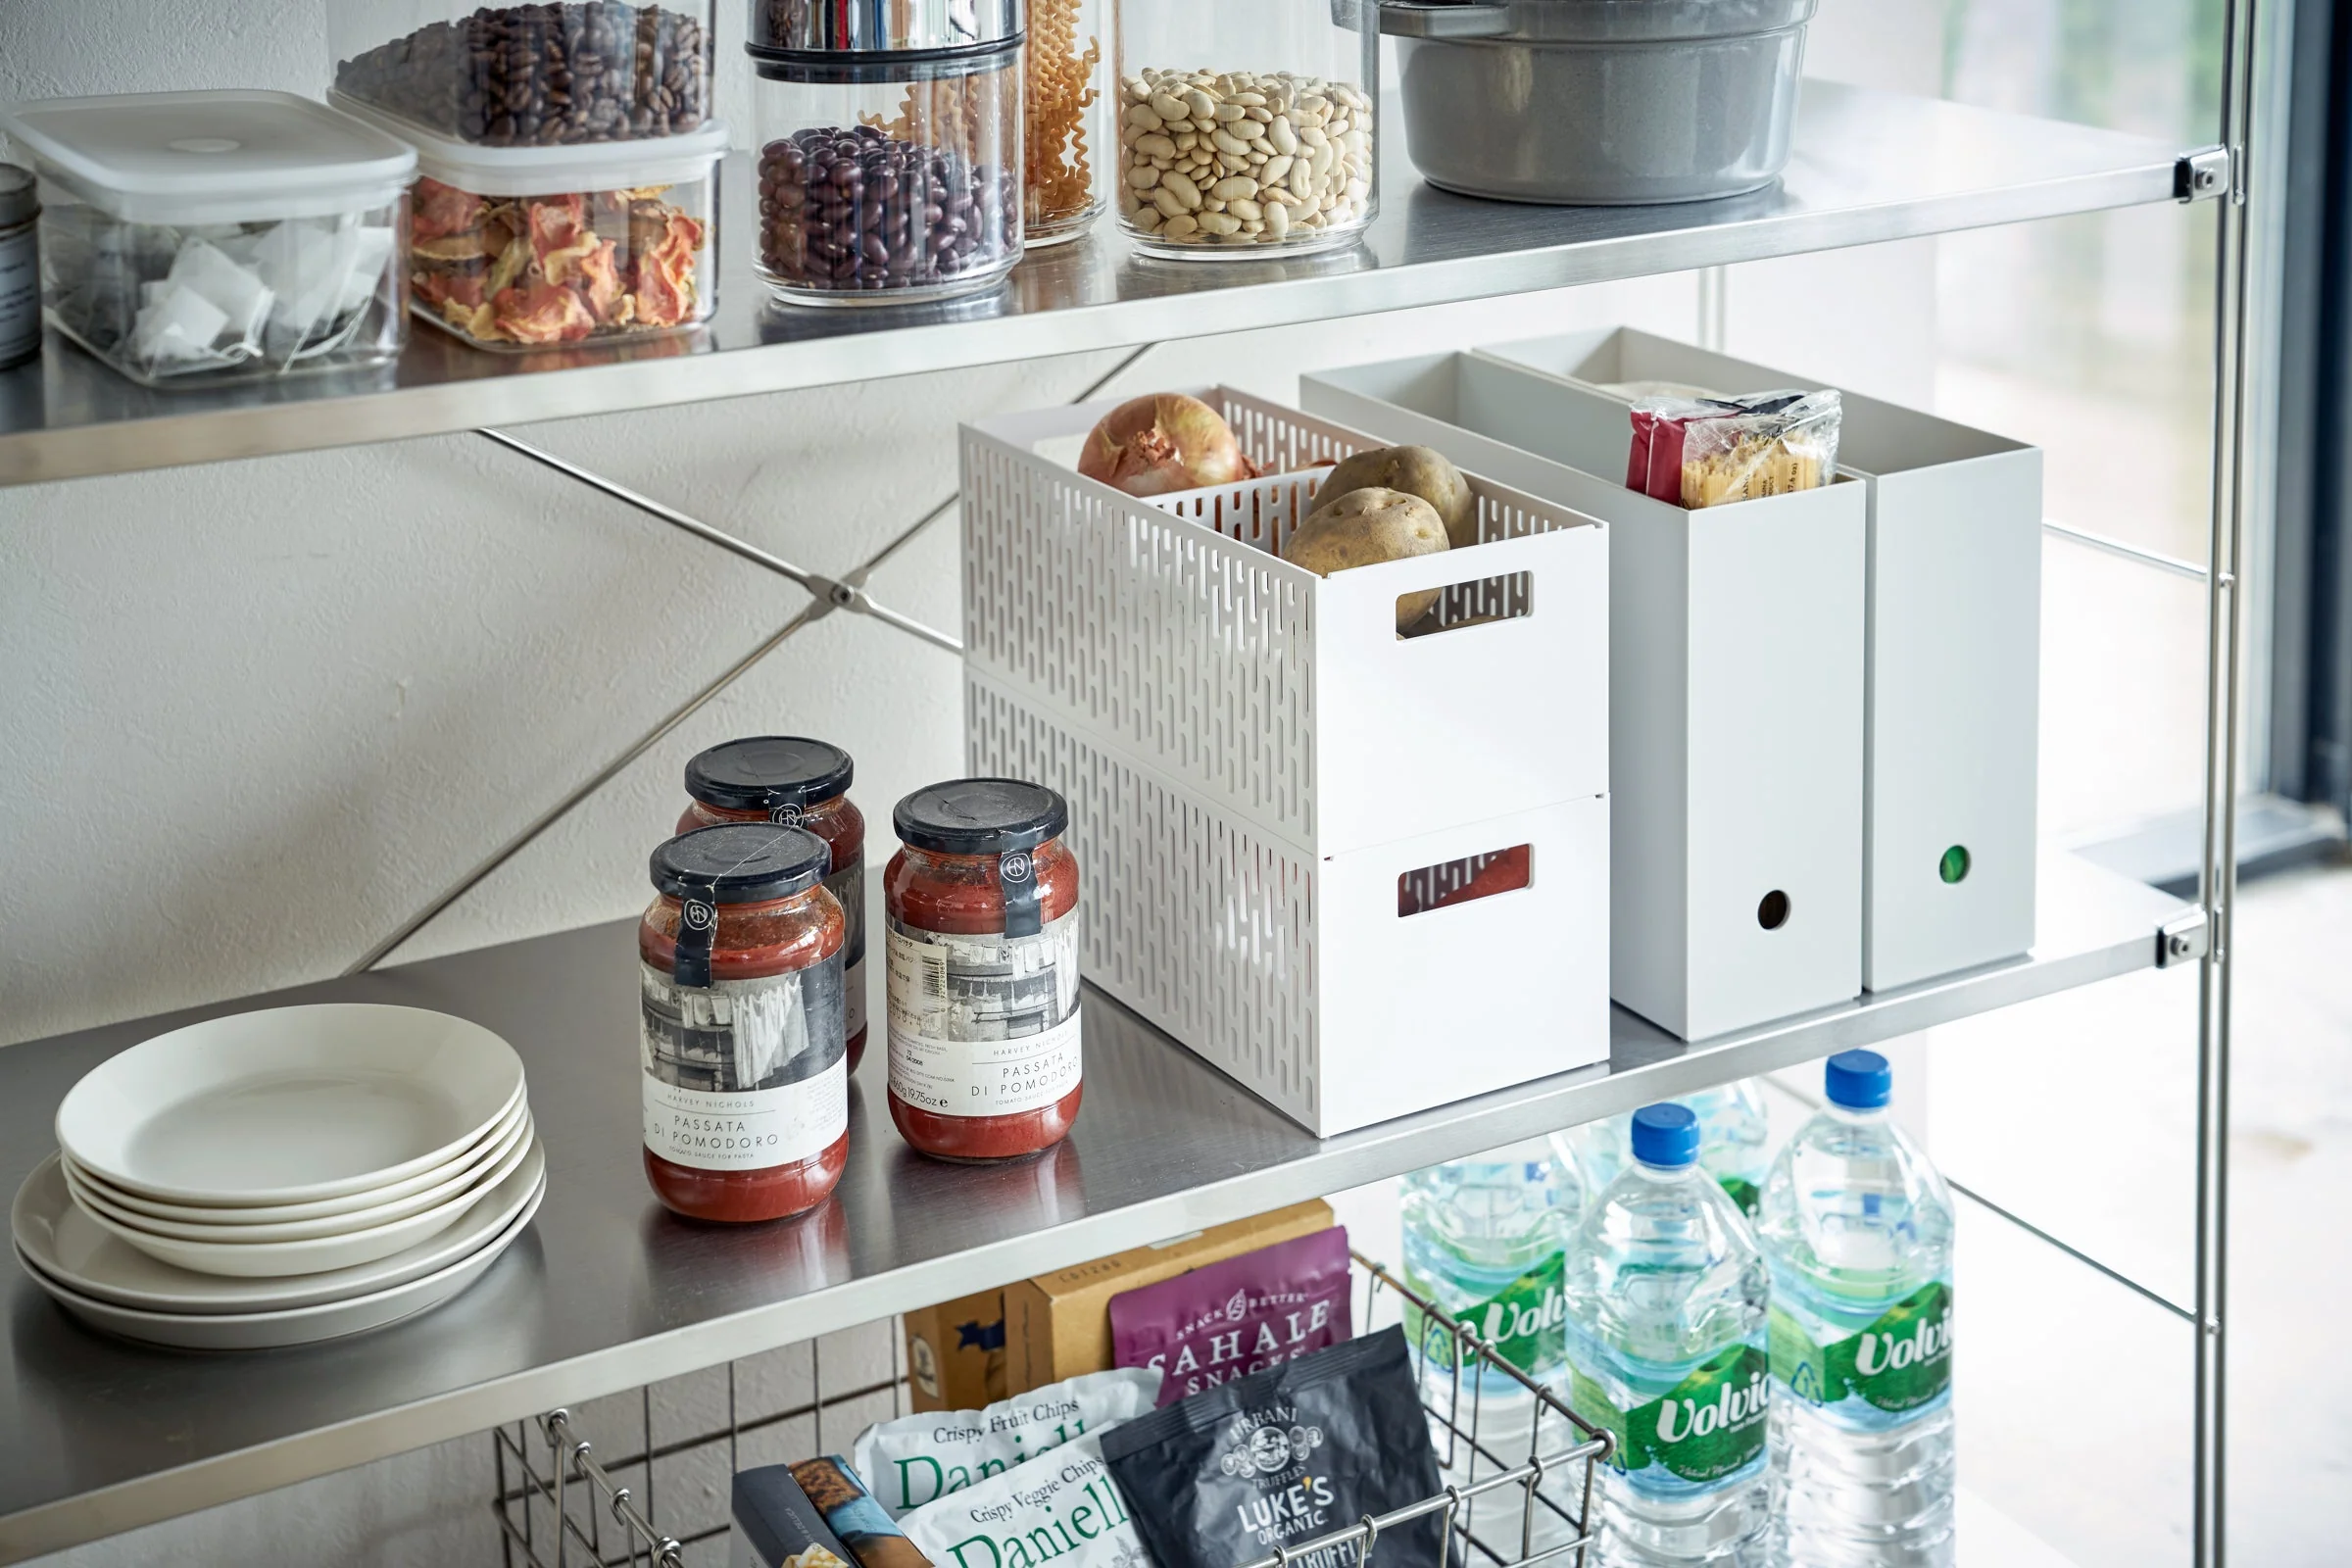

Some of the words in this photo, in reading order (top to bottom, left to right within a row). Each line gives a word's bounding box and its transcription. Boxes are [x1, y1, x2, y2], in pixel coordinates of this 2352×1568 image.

[1003, 1053, 1064, 1079] PASSATA
[971, 1086, 988, 1097] DI
[654, 1123, 664, 1138] DI
[672, 1131, 778, 1150] POMODORO
[674, 1115, 746, 1133] PASSATA
[1176, 1309, 1224, 1341] SNACK
[1855, 1306, 1952, 1376] Volvi
[933, 1425, 985, 1446] Crispy
[990, 1409, 1030, 1434] Fruit
[1033, 1398, 1081, 1423] Chips
[1229, 1406, 1298, 1442] URBANI
[969, 1501, 1013, 1524] Crispy
[1011, 1479, 1061, 1507] Veggie
[1060, 1455, 1106, 1484] Chips
[1237, 1476, 1335, 1534] LUKE'S
[1257, 1509, 1326, 1545] ORGANIC
